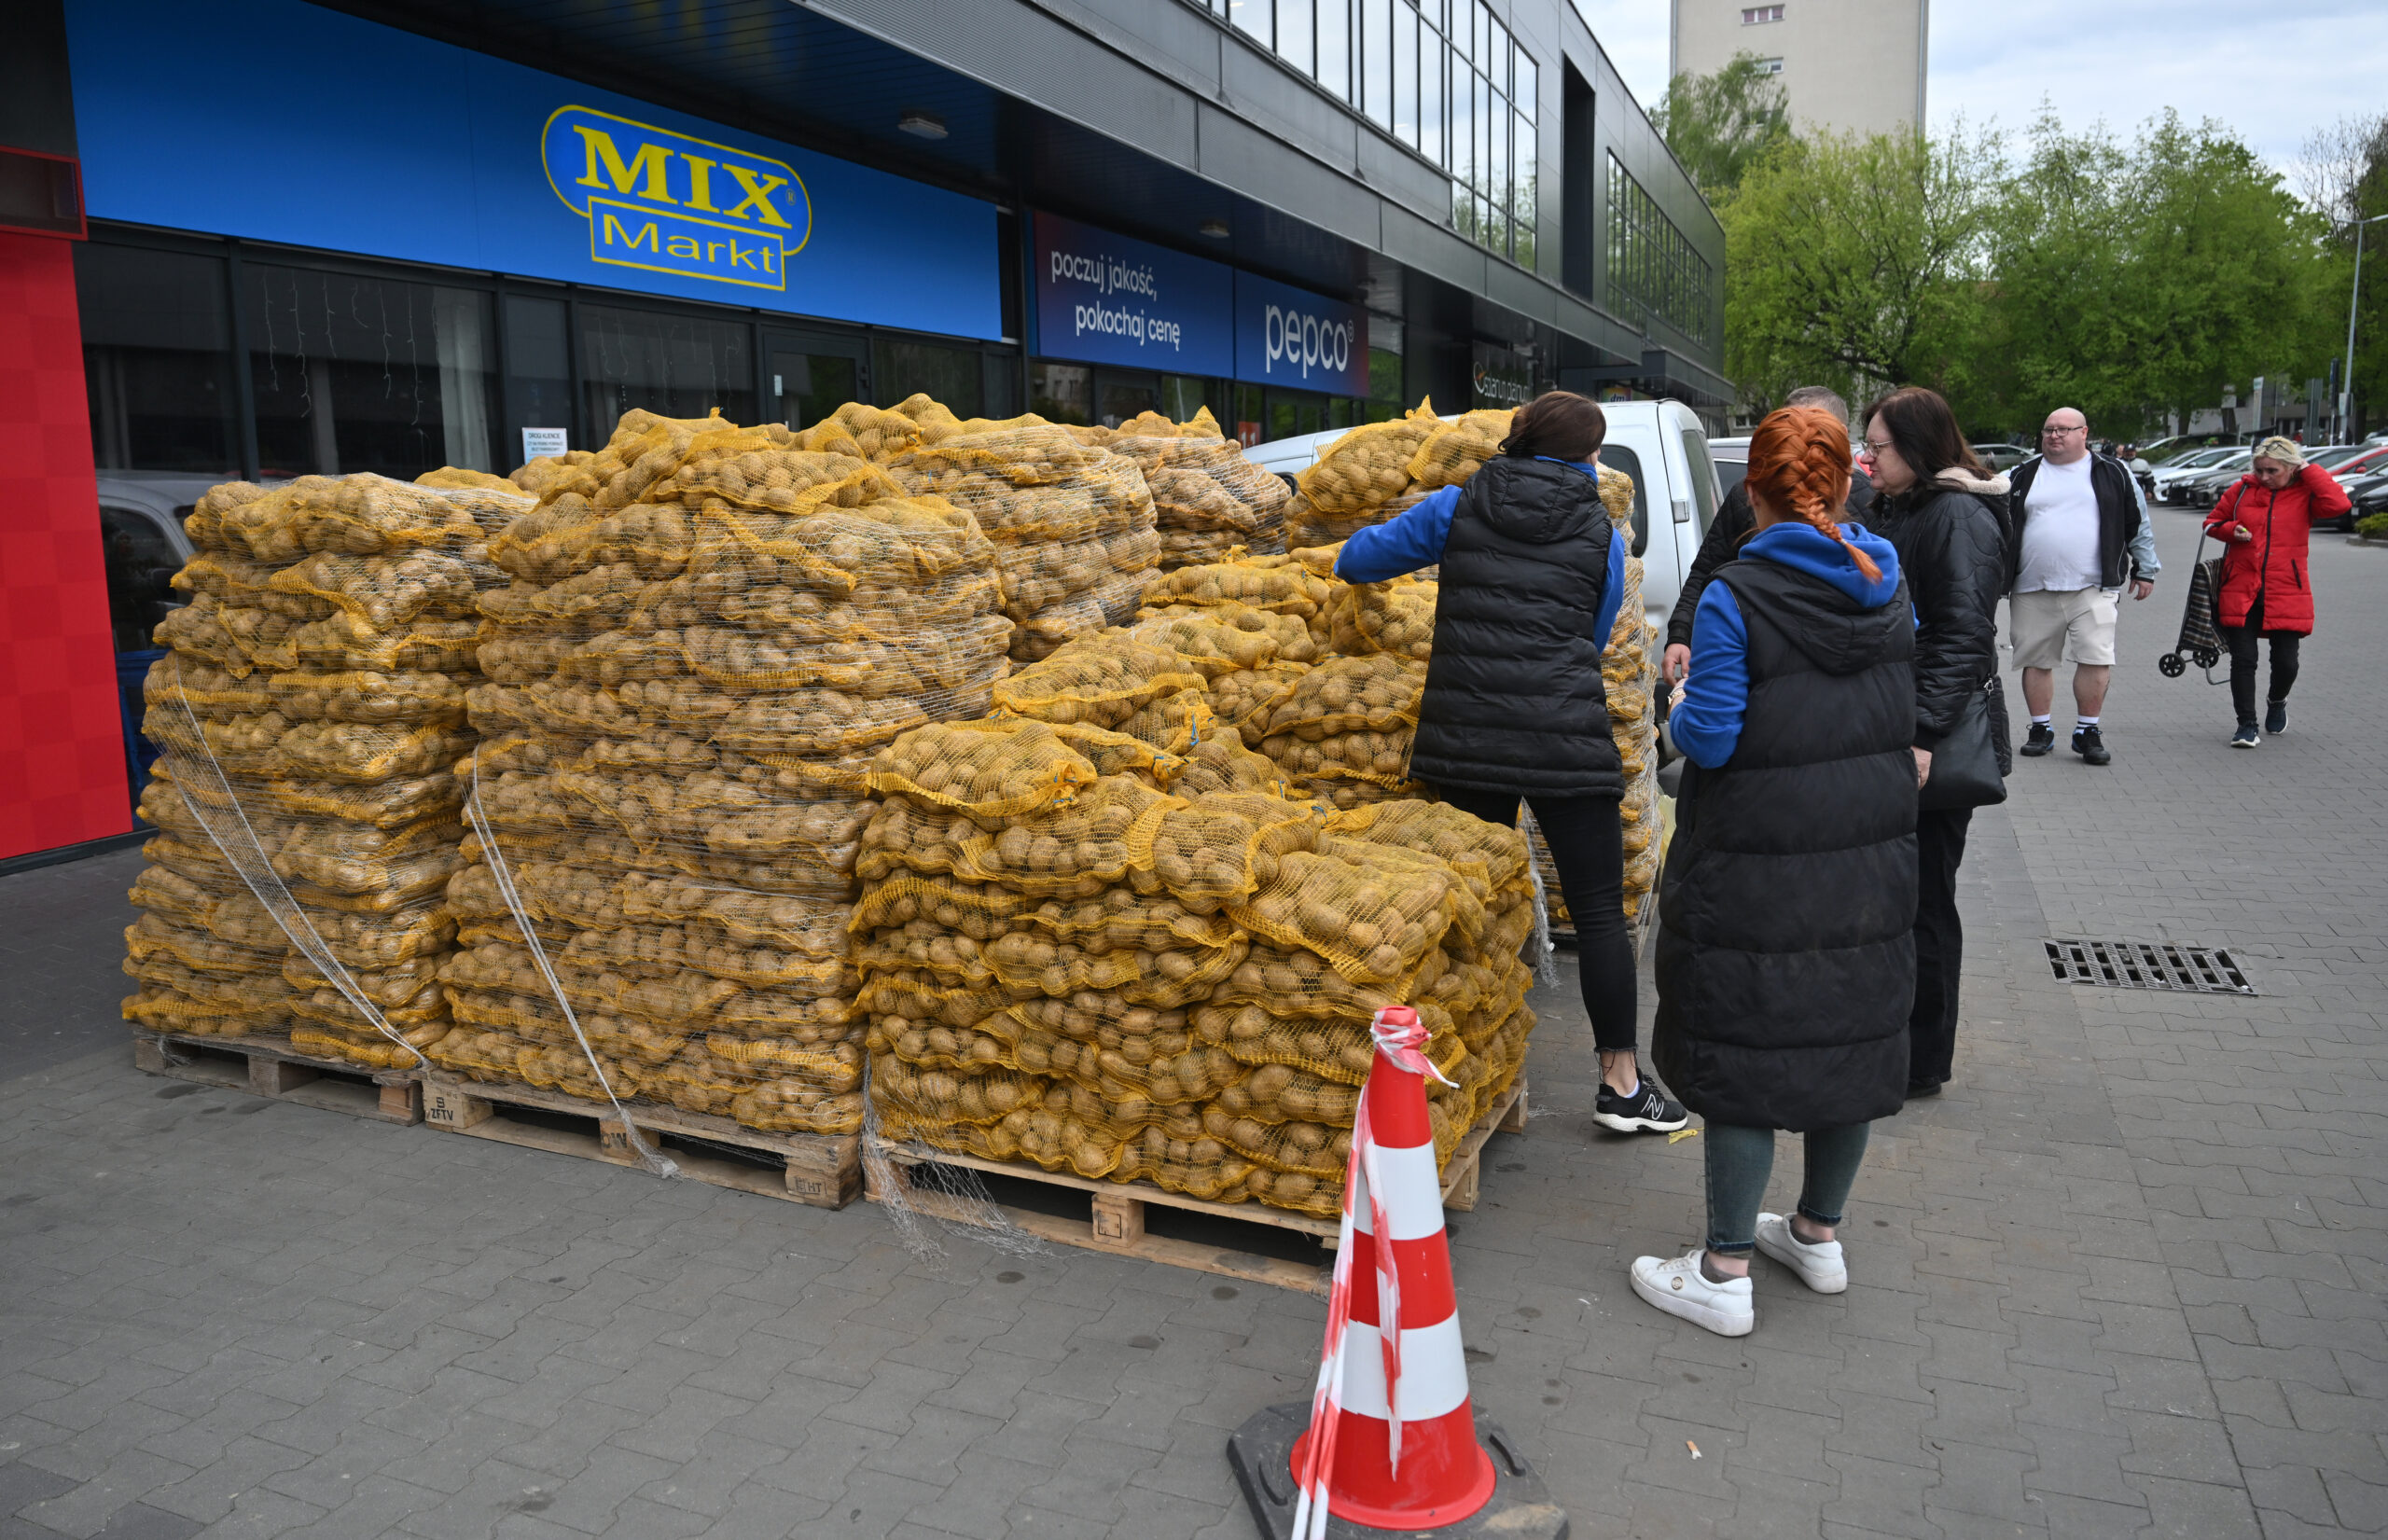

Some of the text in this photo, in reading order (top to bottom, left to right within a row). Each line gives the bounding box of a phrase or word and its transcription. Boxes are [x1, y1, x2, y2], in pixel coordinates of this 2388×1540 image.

[573, 124, 792, 229] MIX
[603, 214, 776, 273] Markt
[1051, 251, 1158, 302] poczuj jakość,
[1076, 300, 1180, 352] pokochaj cenę
[1610, 393, 1625, 402] dm
